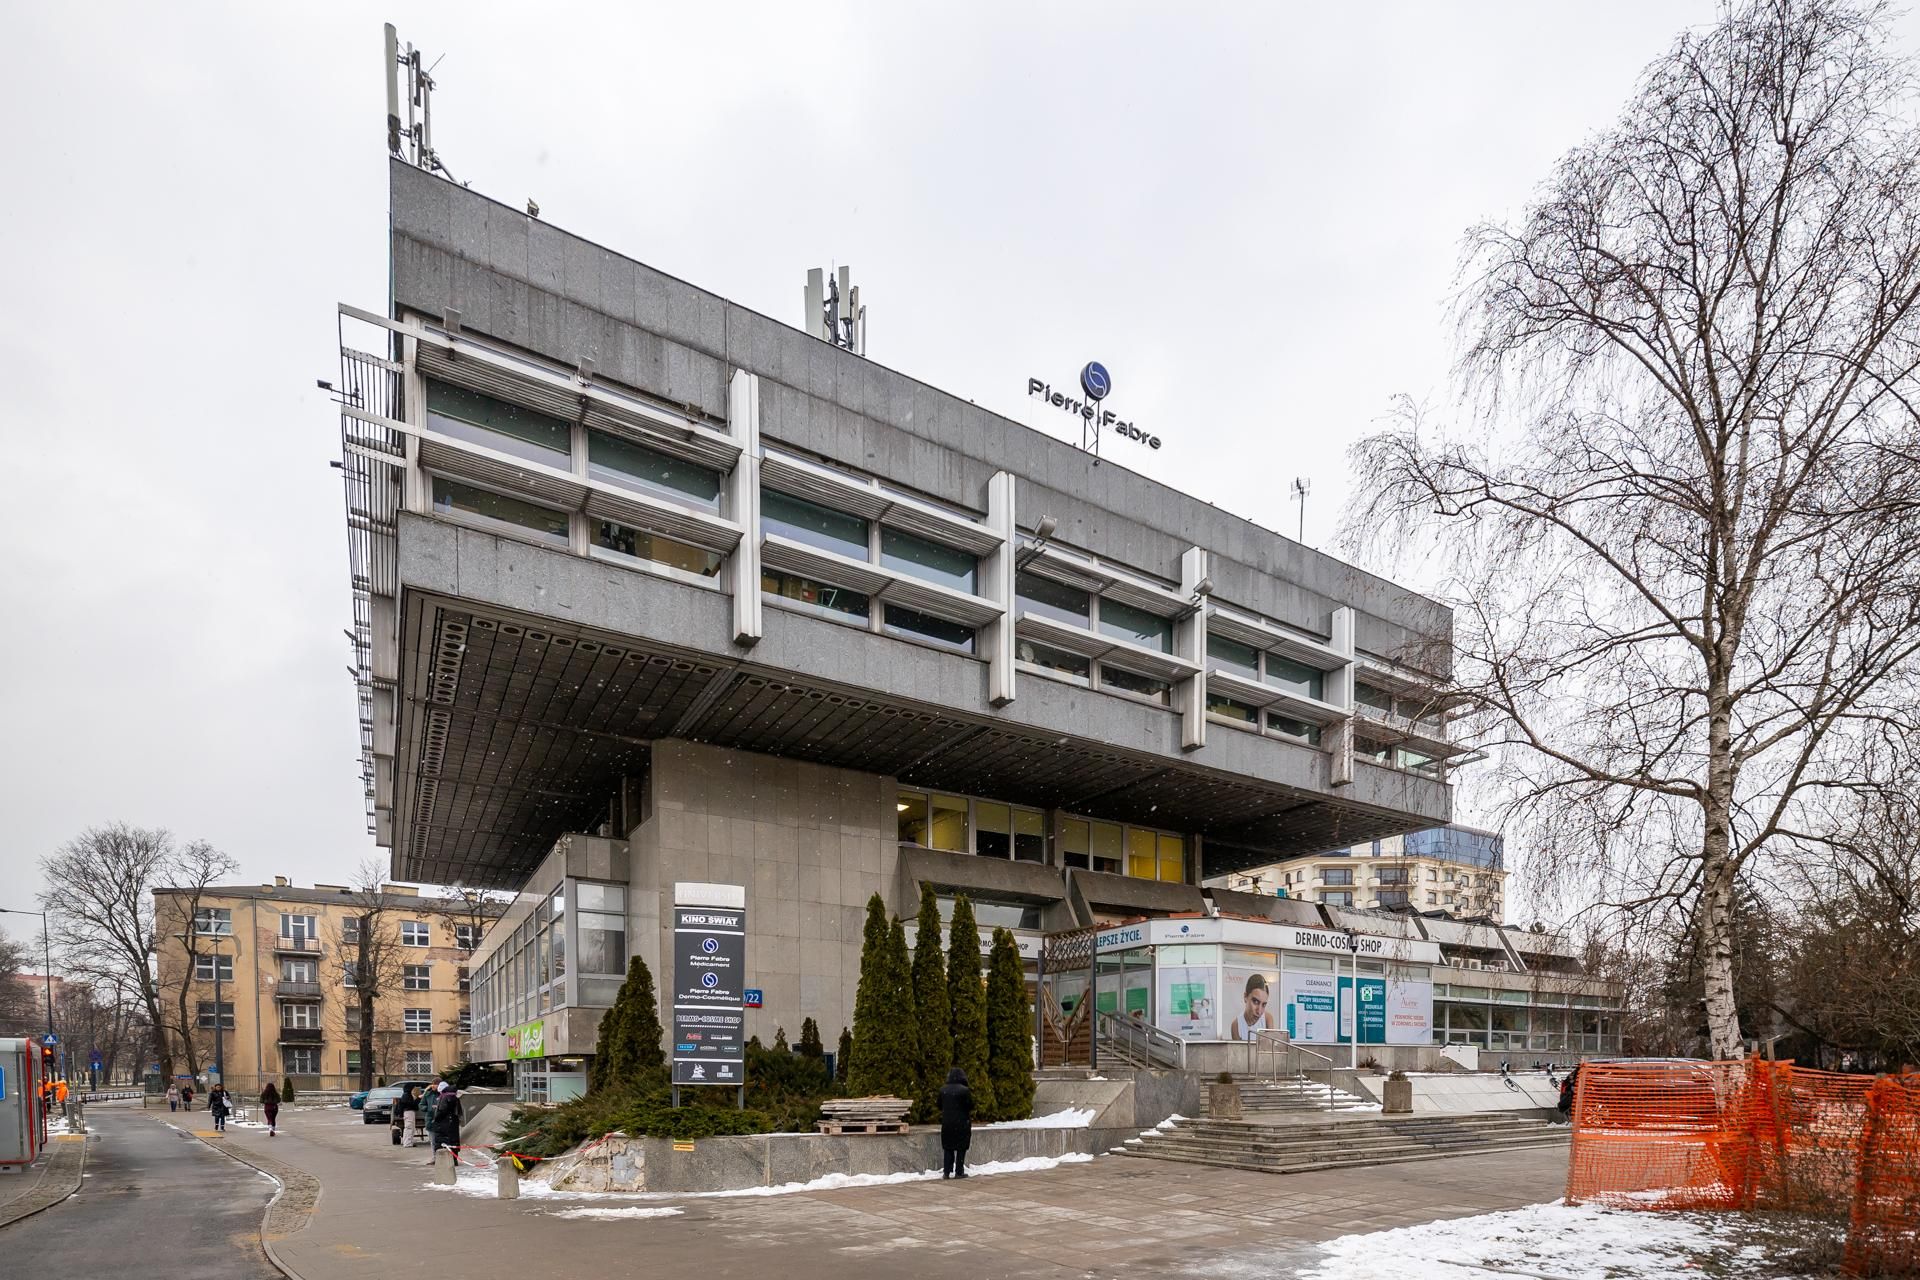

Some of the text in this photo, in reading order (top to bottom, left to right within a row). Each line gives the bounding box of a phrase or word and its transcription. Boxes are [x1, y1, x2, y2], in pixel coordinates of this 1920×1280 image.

[1028, 377, 1162, 450] Pierre Fabre
[681, 914, 706, 924] KINO
[1095, 933, 1119, 948] LEPSZE
[1120, 929, 1142, 944] ŻYCIE.
[1360, 938, 1382, 953] SHOP
[743, 993, 760, 1003] /22
[676, 1014, 742, 1024] DERMO-COSME SHOP
